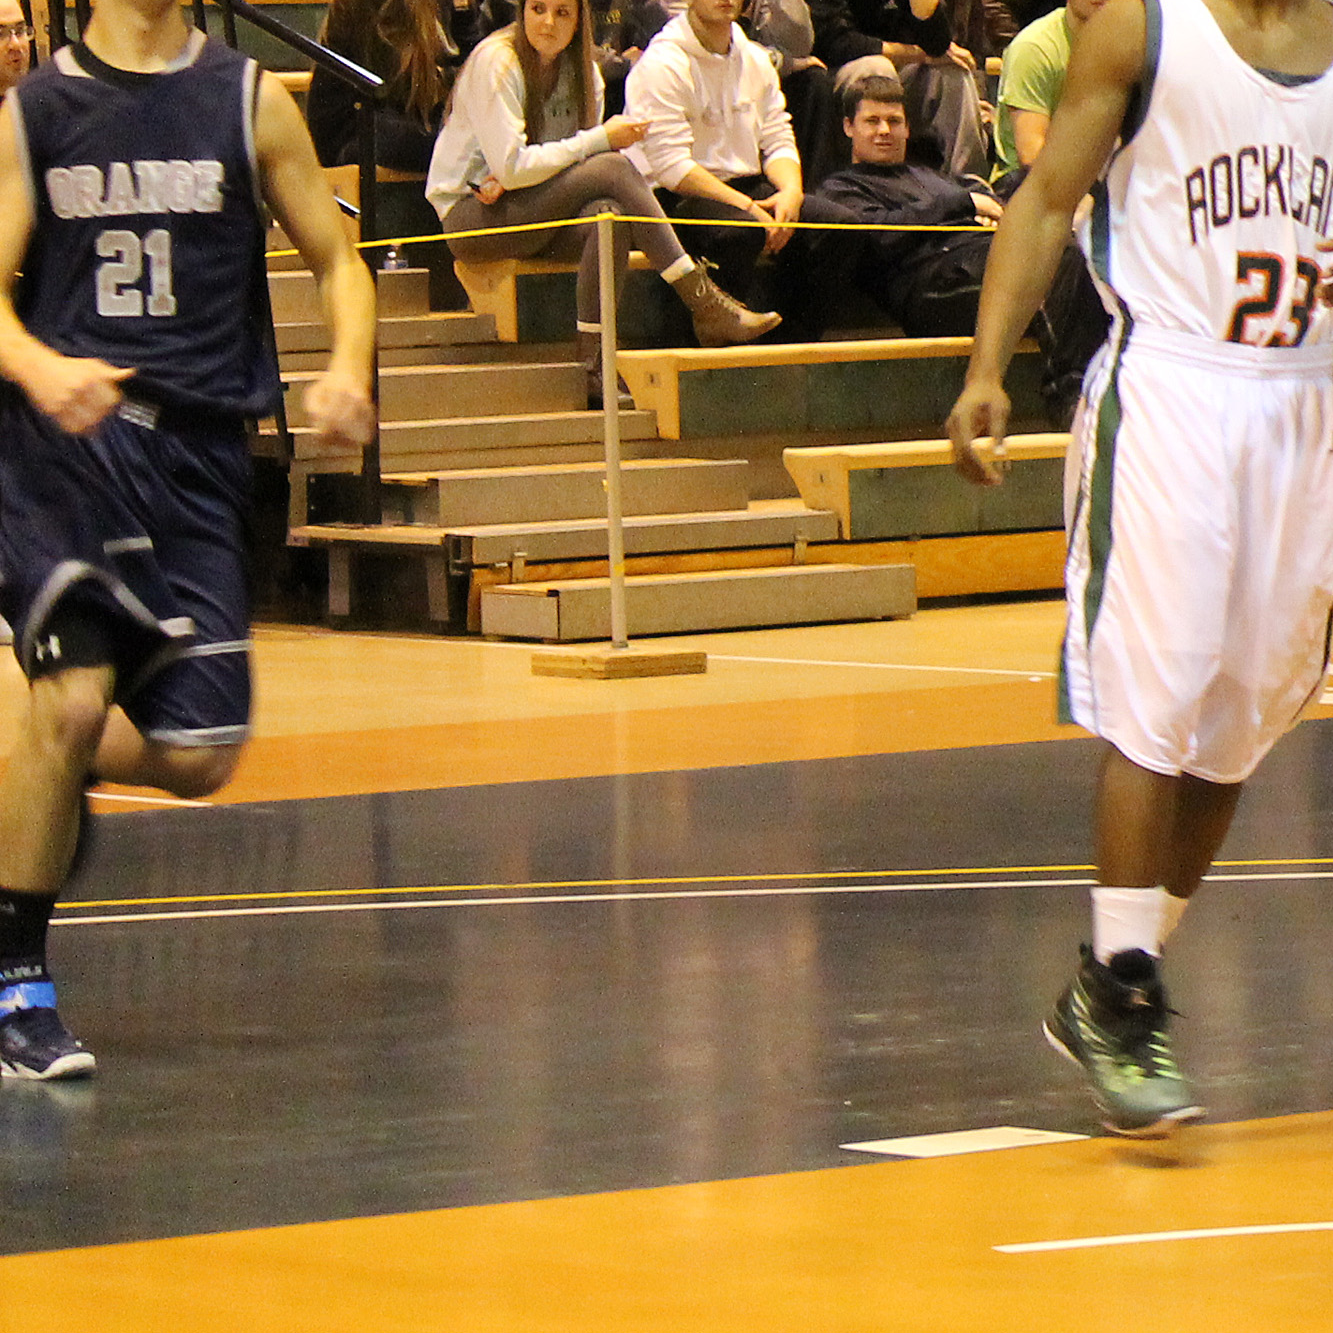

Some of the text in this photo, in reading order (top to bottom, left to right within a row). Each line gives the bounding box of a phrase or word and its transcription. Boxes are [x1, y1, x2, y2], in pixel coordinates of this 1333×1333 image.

[45, 160, 225, 219] ORANGE
[95, 229, 177, 317] 21
[1224, 250, 1323, 348] 23
